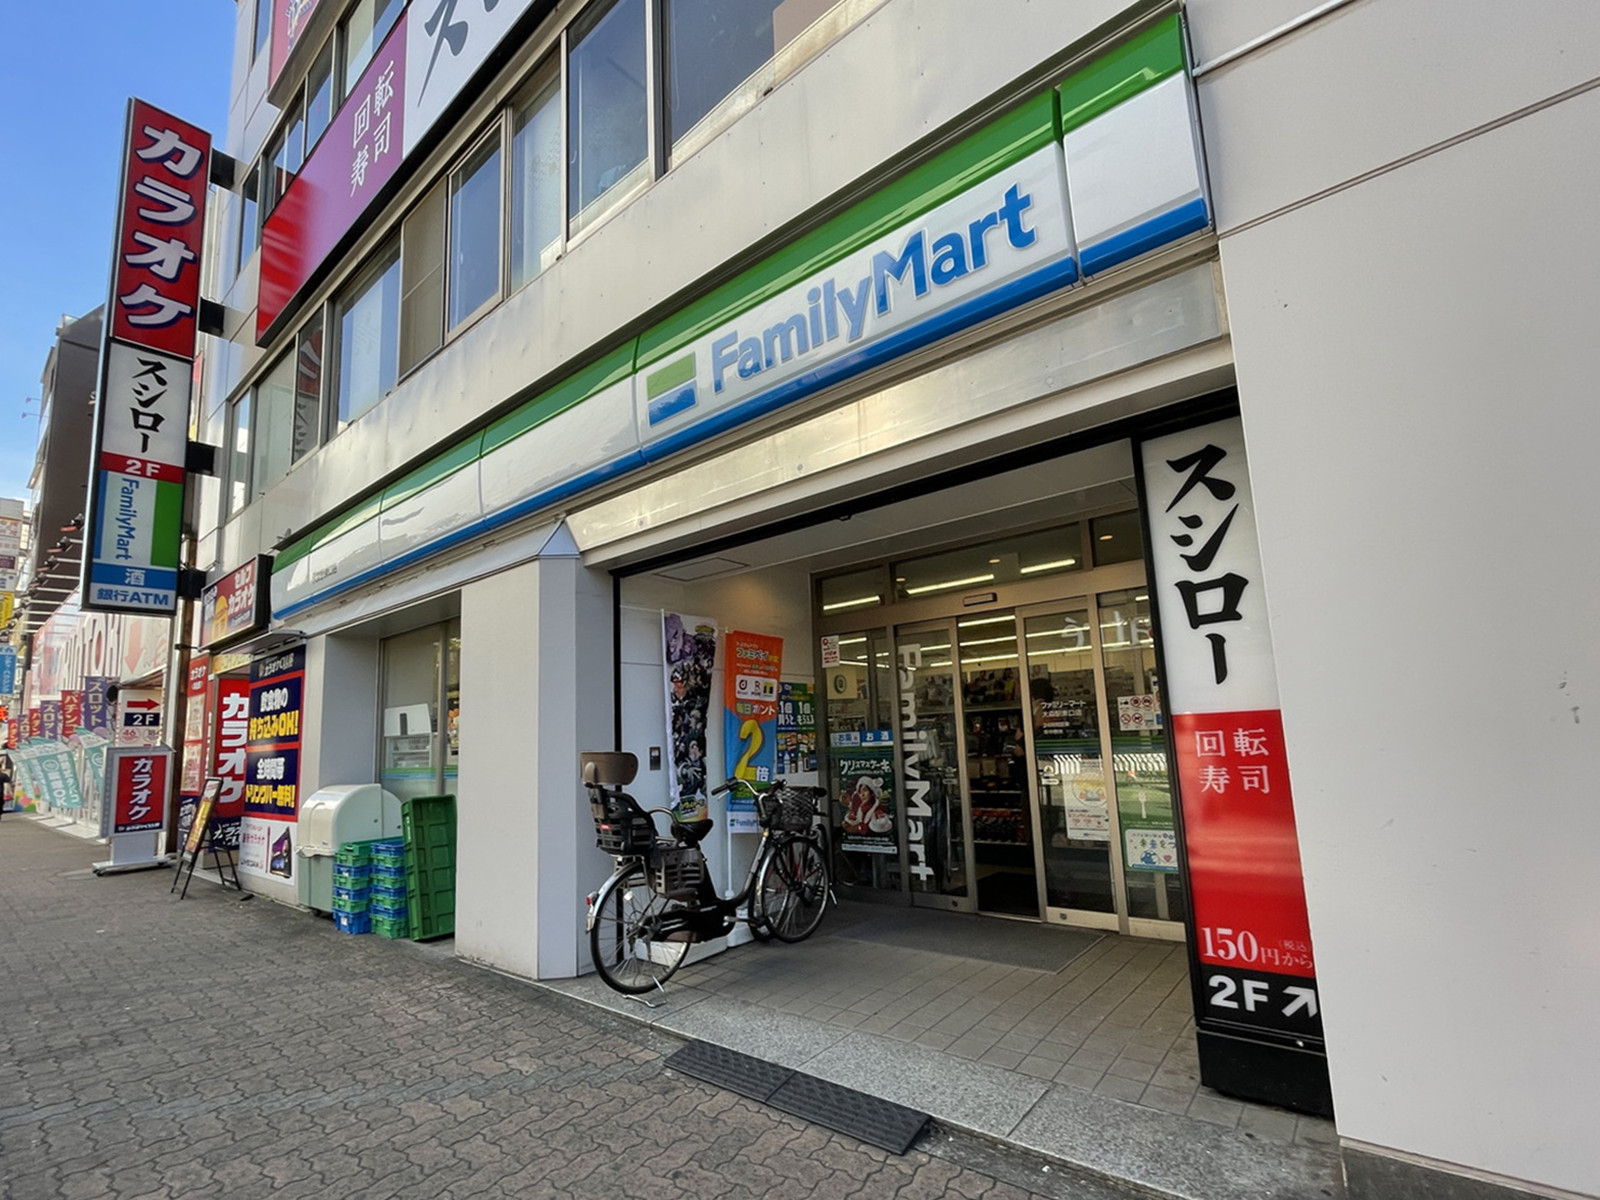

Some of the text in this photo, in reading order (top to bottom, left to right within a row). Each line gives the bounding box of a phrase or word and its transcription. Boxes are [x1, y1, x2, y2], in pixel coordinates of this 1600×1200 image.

[120, 124, 202, 326] カラオケ
[711, 182, 1036, 394] FamilyMart
[130, 356, 168, 454] スシロー
[125, 459, 161, 477] 2F
[115, 477, 140, 560] FamilyMart
[124, 567, 146, 586] 酒
[1165, 444, 1250, 685] スシロー
[97, 587, 169, 606] 銀行ATM
[88, 681, 103, 727] スロット
[132, 714, 155, 726] 2F
[1041, 699, 1087, 709] ファミリーマート
[217, 692, 250, 804] カラオケ
[899, 643, 935, 882] FamilyMart
[1195, 727, 1269, 758] 回転
[128, 758, 154, 820] カラオケ
[1200, 764, 1271, 794] 寿司
[1208, 974, 1270, 1013] 2F
